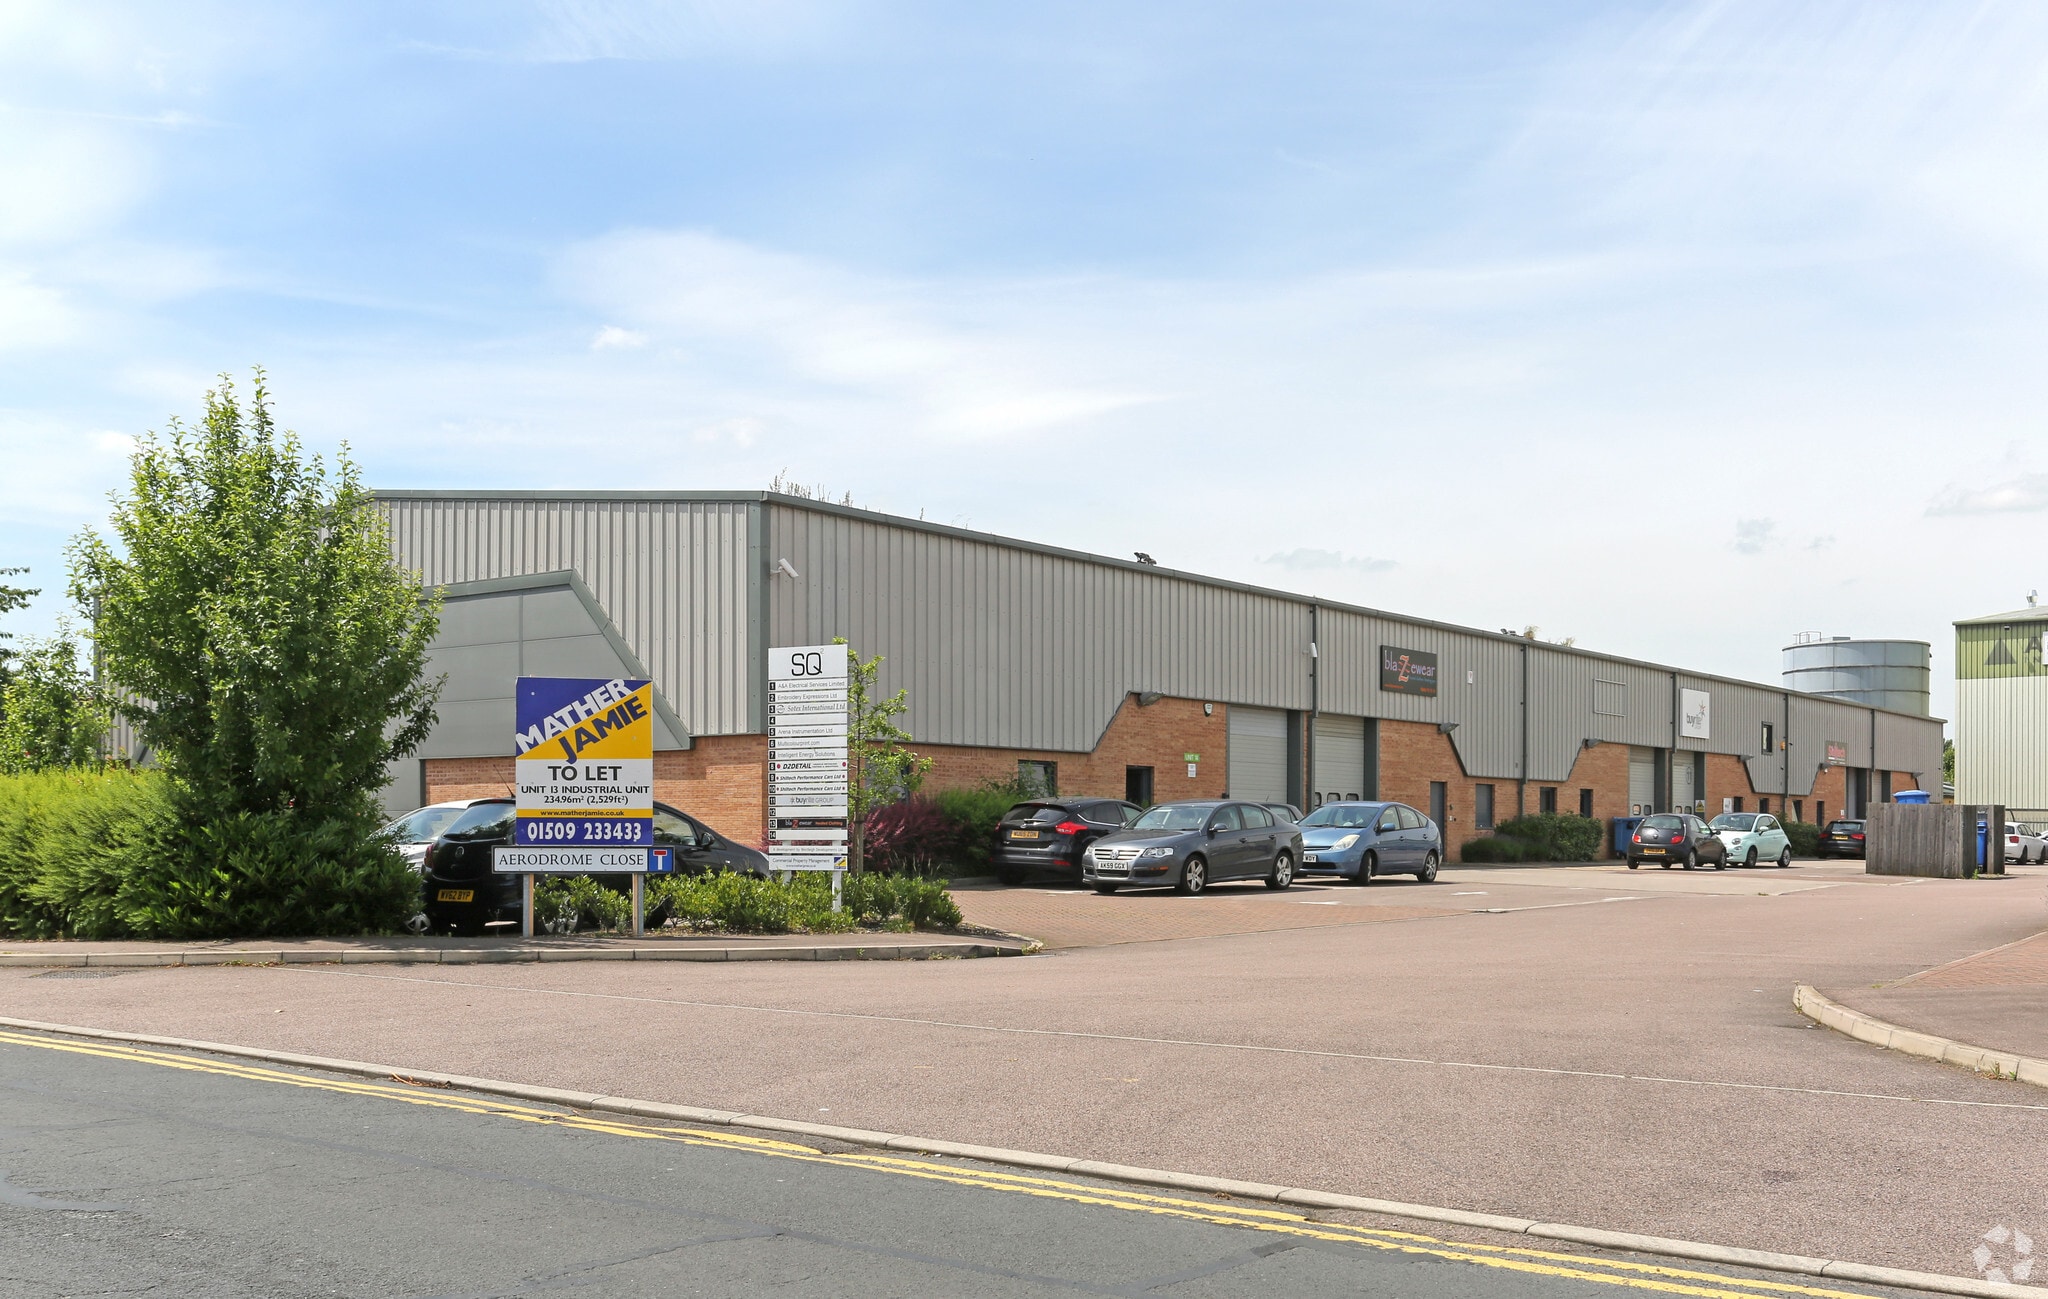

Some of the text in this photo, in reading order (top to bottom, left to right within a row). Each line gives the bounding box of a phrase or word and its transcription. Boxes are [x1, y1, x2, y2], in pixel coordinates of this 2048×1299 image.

[515, 679, 634, 754] MATHER
[558, 695, 648, 764] JAMIE
[548, 765, 622, 781] TO LET
[521, 786, 650, 794] UNIT 13 INDUSTRIAL UNIT
[527, 822, 642, 840] 01509 233433
[499, 854, 644, 866] AERODROME CLOSE
